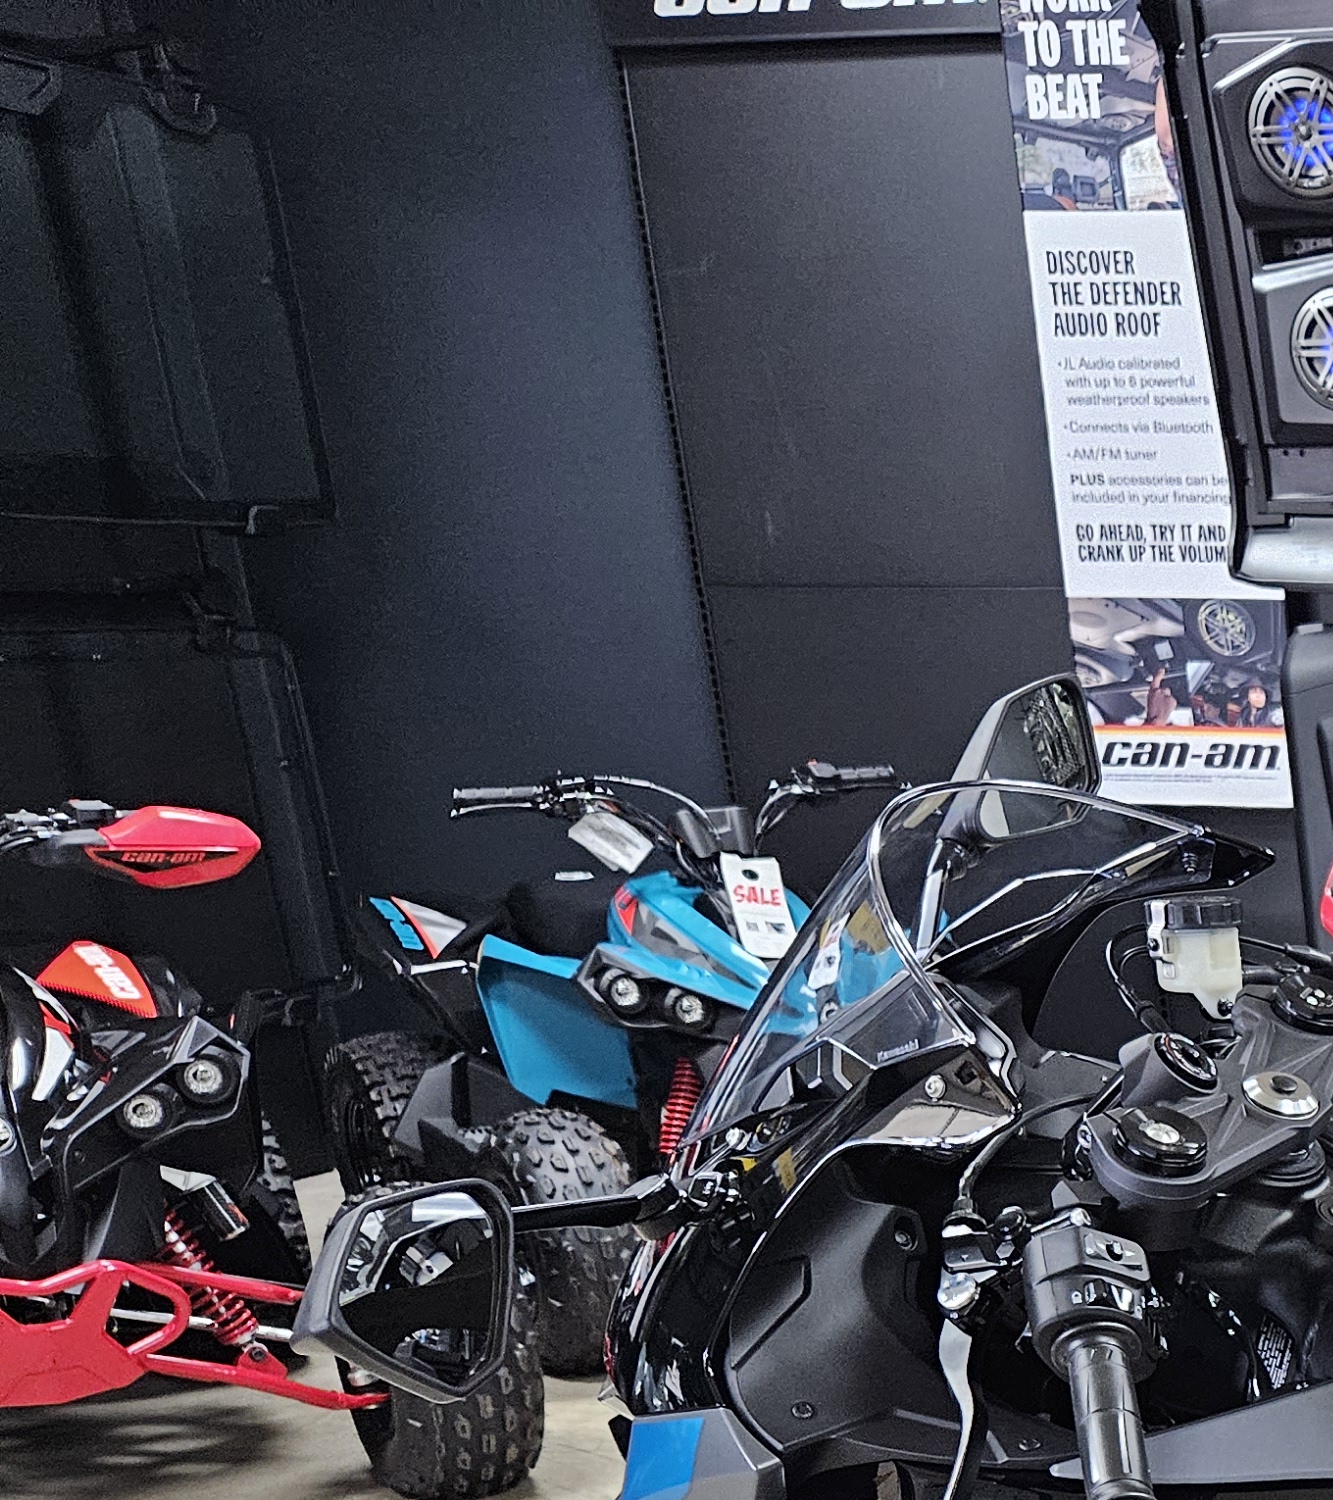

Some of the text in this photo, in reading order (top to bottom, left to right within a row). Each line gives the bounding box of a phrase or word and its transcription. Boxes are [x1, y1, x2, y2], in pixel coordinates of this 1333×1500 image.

[1018, 18, 1129, 67] TO THE
[1025, 74, 1103, 120] BEAT
[1046, 250, 1136, 275] DISCOVER
[1048, 281, 1182, 306] THE DEFENDER
[1054, 312, 1162, 337] AUDIO ROOF
[1078, 357, 1116, 370] Audio
[1118, 356, 1181, 370] calibrated
[1065, 376, 1091, 388] with
[1094, 379, 1110, 391] up
[1113, 376, 1127, 389] to
[1140, 376, 1196, 391] powerful
[1068, 394, 1210, 407] weatherproof speakers
[1069, 420, 1214, 434] Connects via Bluetooth
[1072, 447, 1158, 461] AM/FM tuner
[1070, 474, 1105, 486] PLUS
[1108, 475, 1183, 487] accessories
[1185, 476, 1208, 486] can
[1072, 491, 1126, 504] included
[1128, 491, 1140, 504] in
[1141, 493, 1169, 506] your
[1075, 524, 1226, 543] GO AHEAD, TRY IT AND
[1078, 545, 1228, 562] CRANK UP THE VOLUM
[1101, 741, 1282, 770] can-am
[121, 852, 206, 864] can-am
[732, 884, 783, 907] SALE
